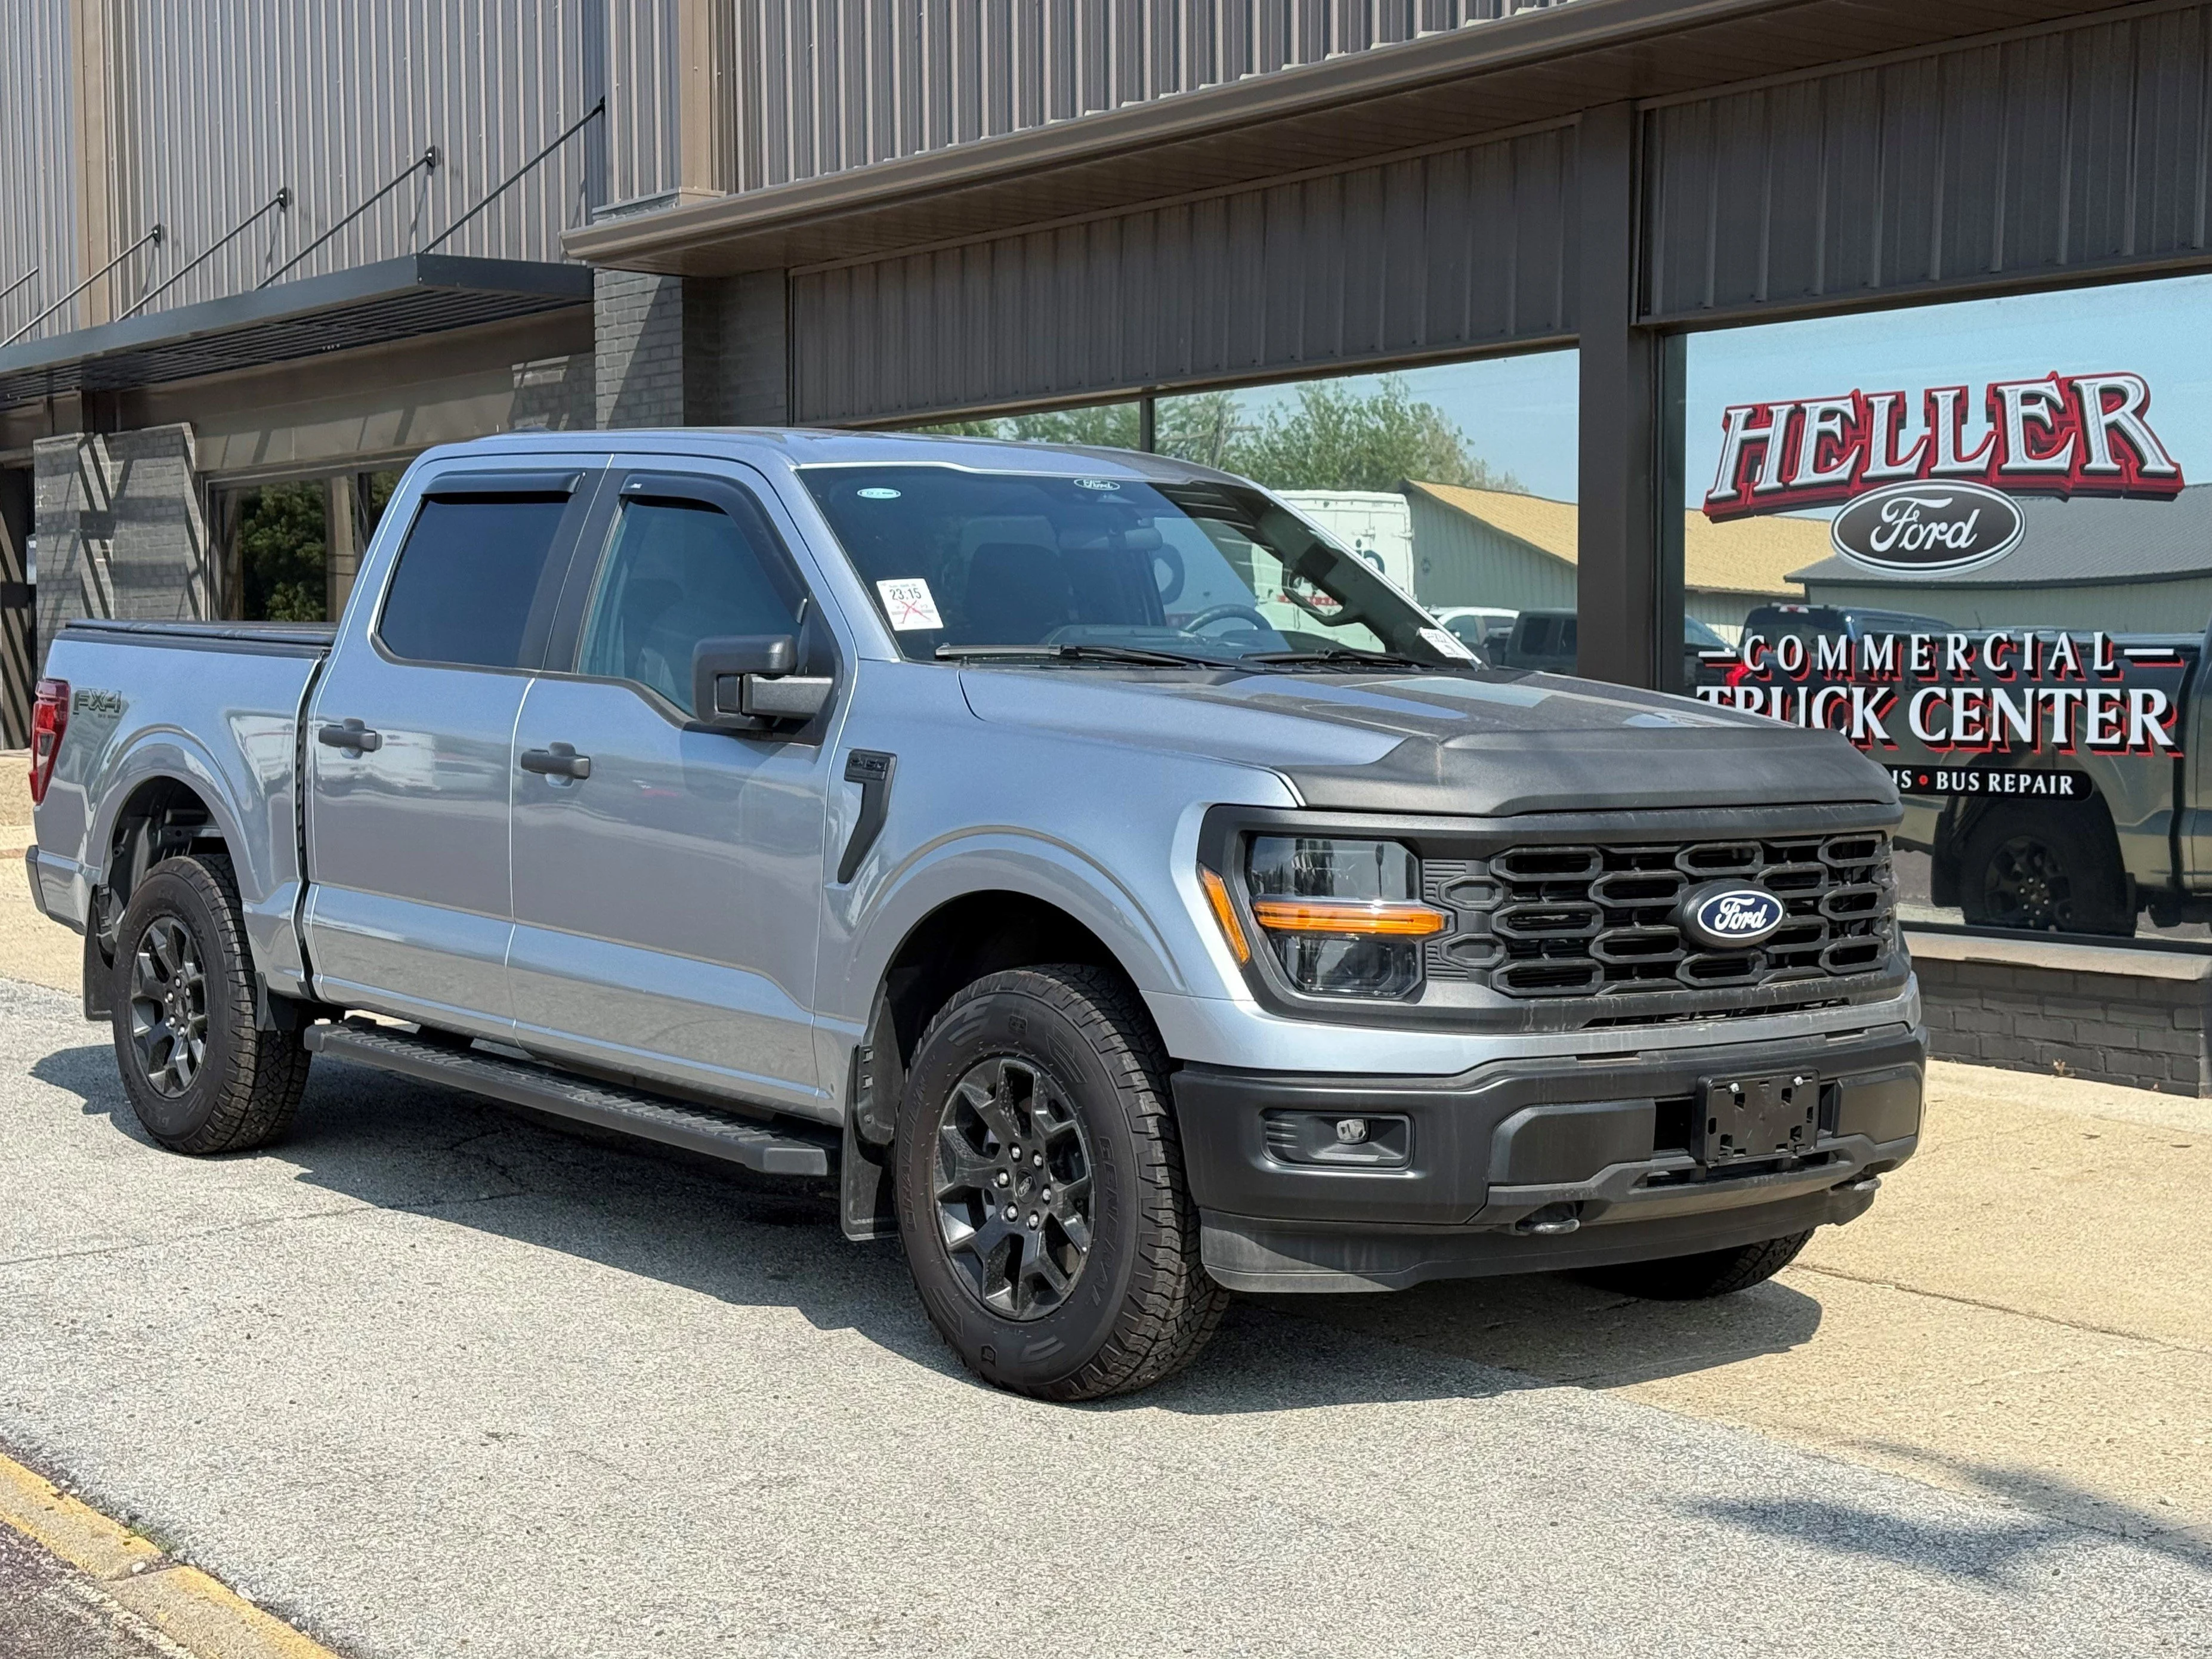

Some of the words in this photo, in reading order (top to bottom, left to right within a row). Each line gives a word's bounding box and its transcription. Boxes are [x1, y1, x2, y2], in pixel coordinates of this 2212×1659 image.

[1706, 373, 2180, 506] HELLER
[1870, 496, 1981, 552] Ford
[1743, 631, 2114, 672] COMMERCIAL
[73, 687, 122, 715] FX4
[1908, 687, 2174, 745] CENTER
[1936, 771, 1979, 791] BUS
[1988, 773, 2073, 795] REPAIR
[1714, 897, 1768, 931] Ford
